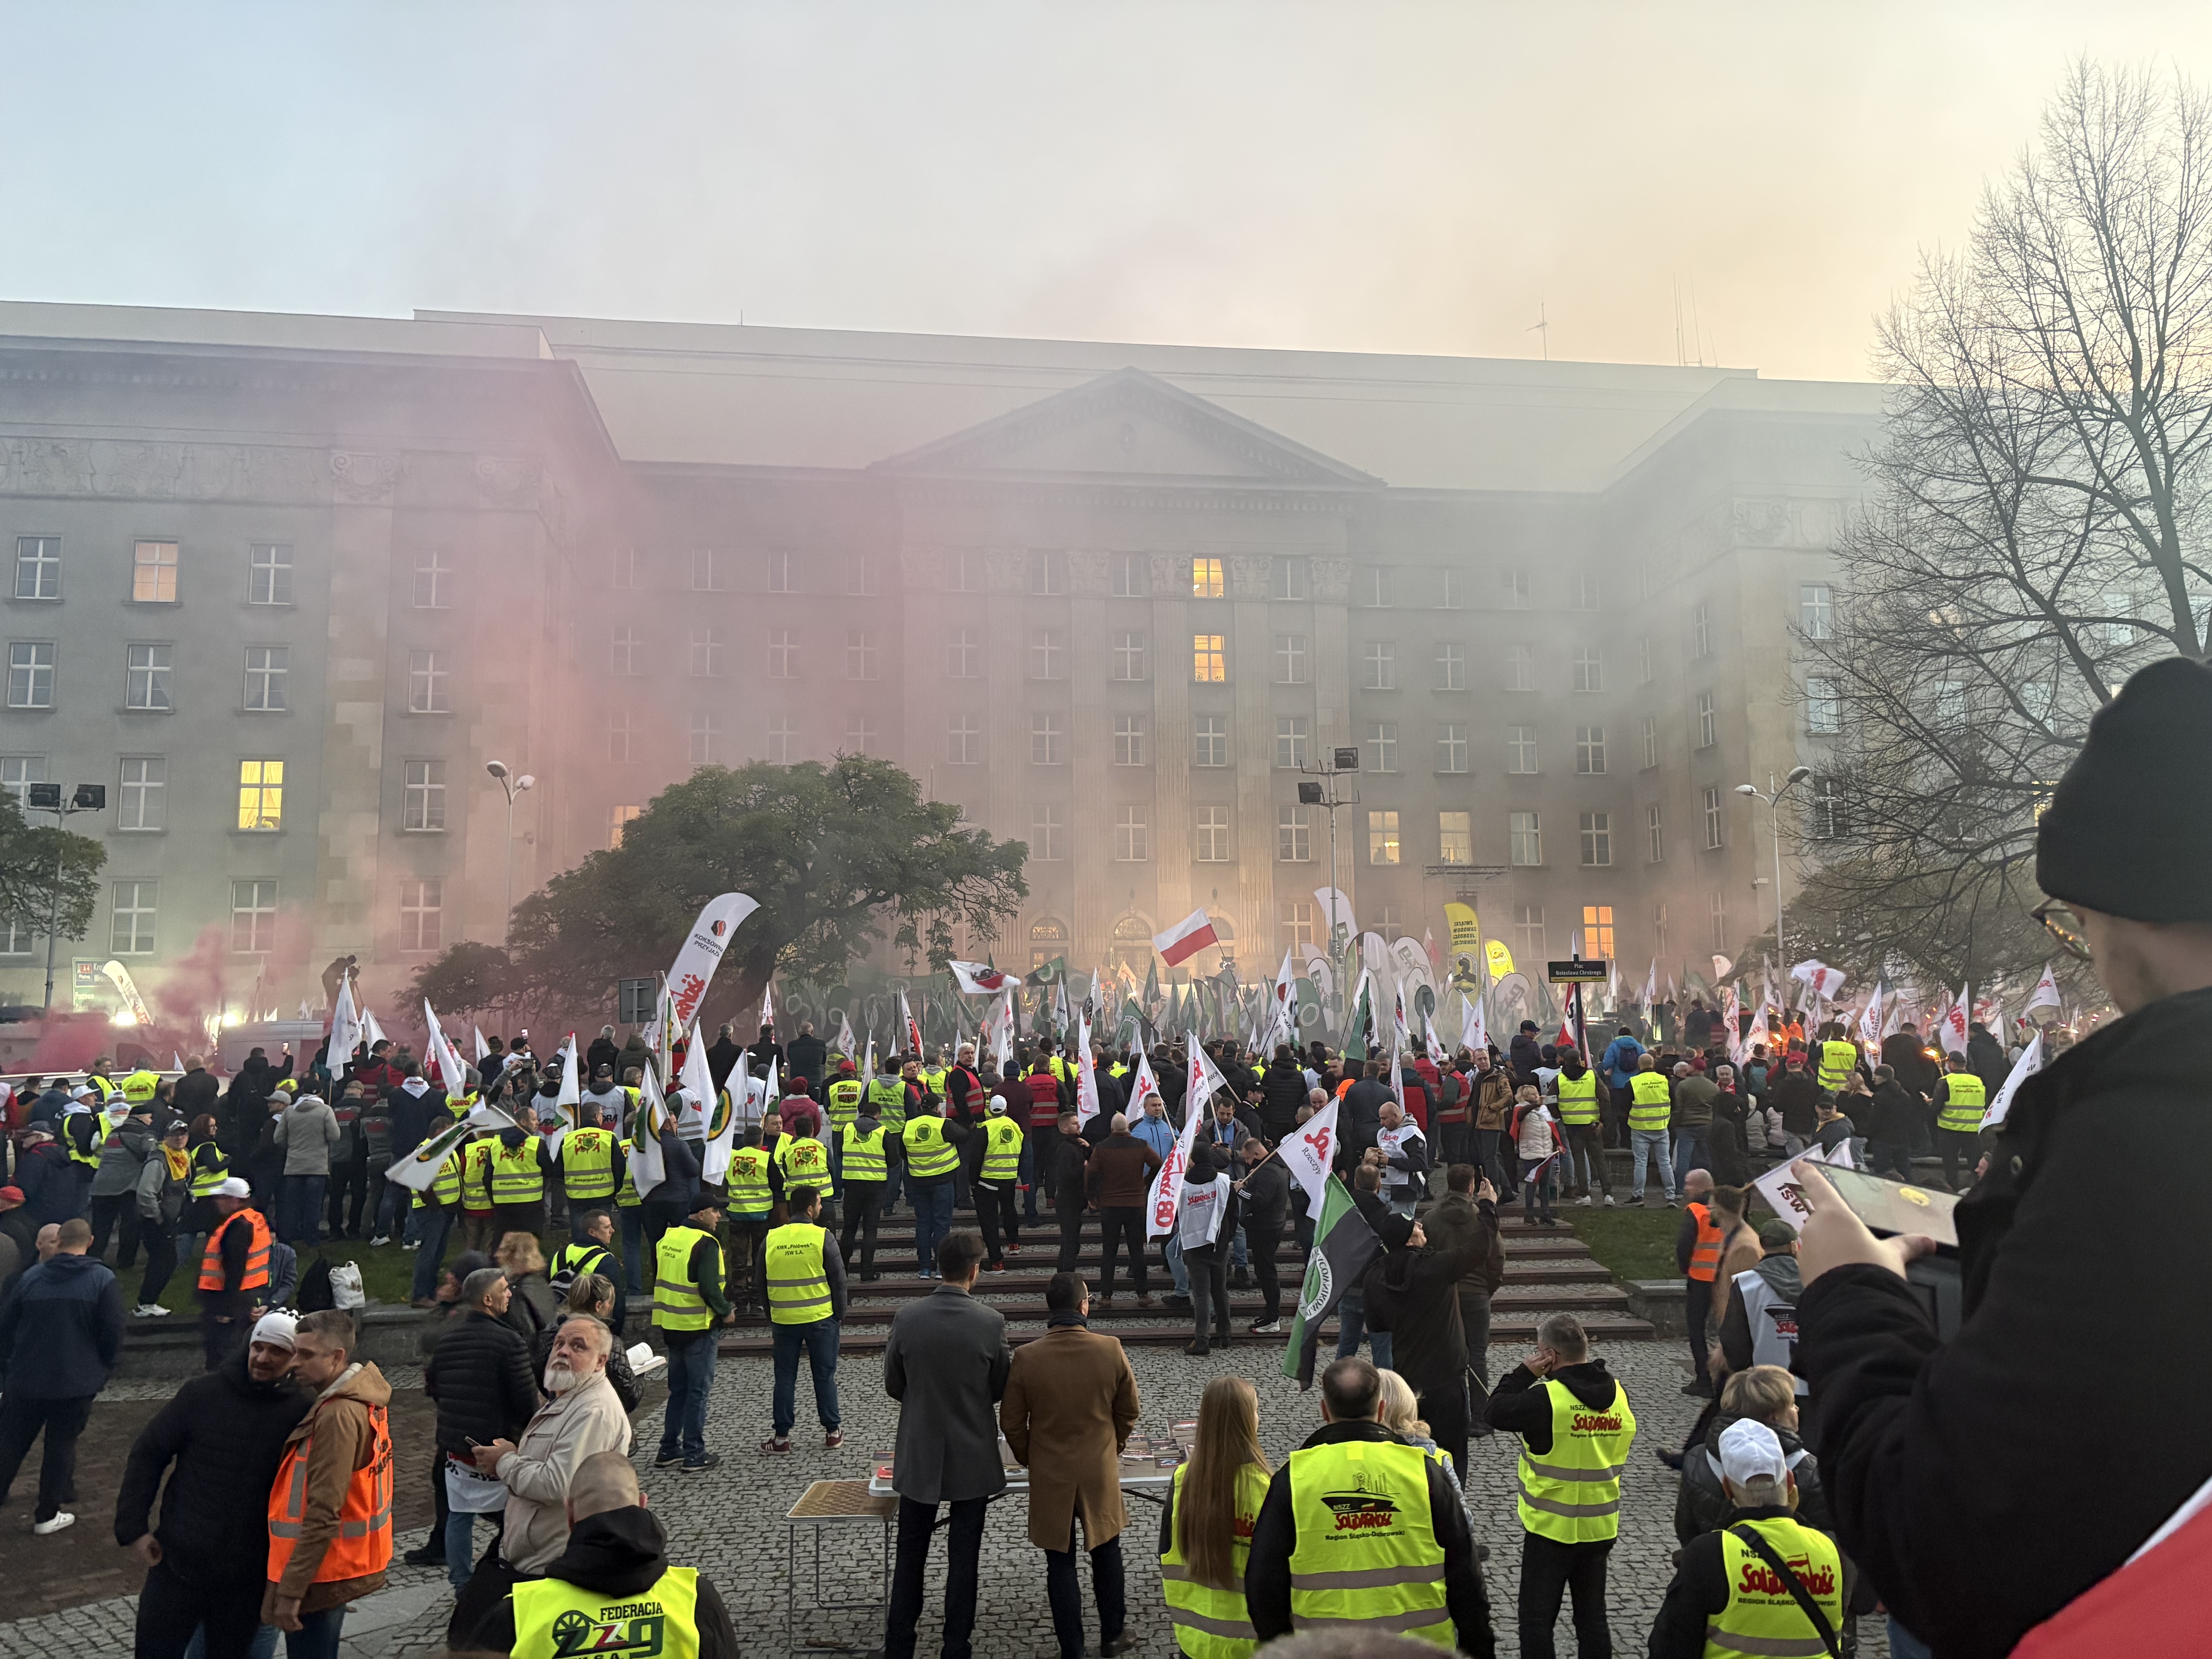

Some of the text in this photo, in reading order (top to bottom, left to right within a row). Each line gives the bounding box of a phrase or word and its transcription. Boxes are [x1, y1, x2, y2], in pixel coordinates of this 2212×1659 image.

[1156, 1200, 1174, 1227] 80
[1349, 1530, 1405, 1540] Śląsko-Dąbrowski
[1741, 1549, 1759, 1558] NS
[600, 1602, 664, 1621] FEDERACJA
